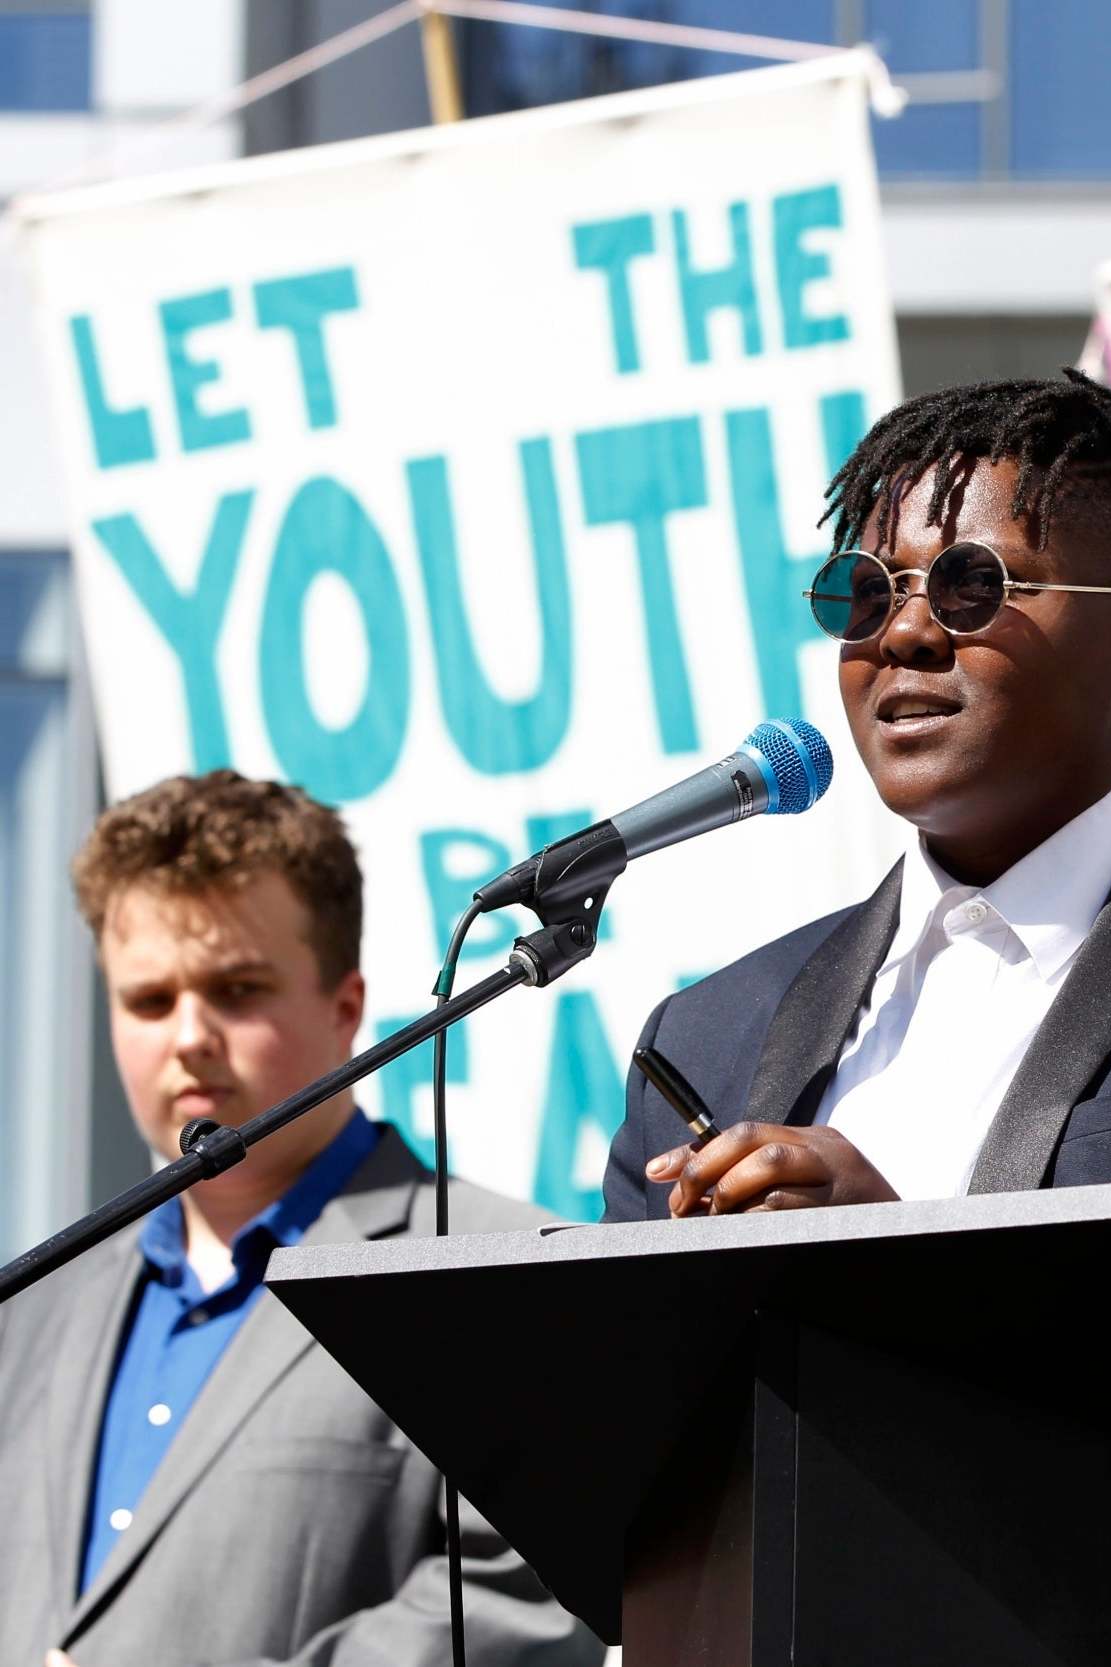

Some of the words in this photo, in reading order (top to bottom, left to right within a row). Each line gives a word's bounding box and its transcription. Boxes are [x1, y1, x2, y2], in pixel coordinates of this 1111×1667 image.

[69, 265, 361, 471] LET
[569, 182, 852, 376] THE
[91, 388, 872, 811] YOUTH
